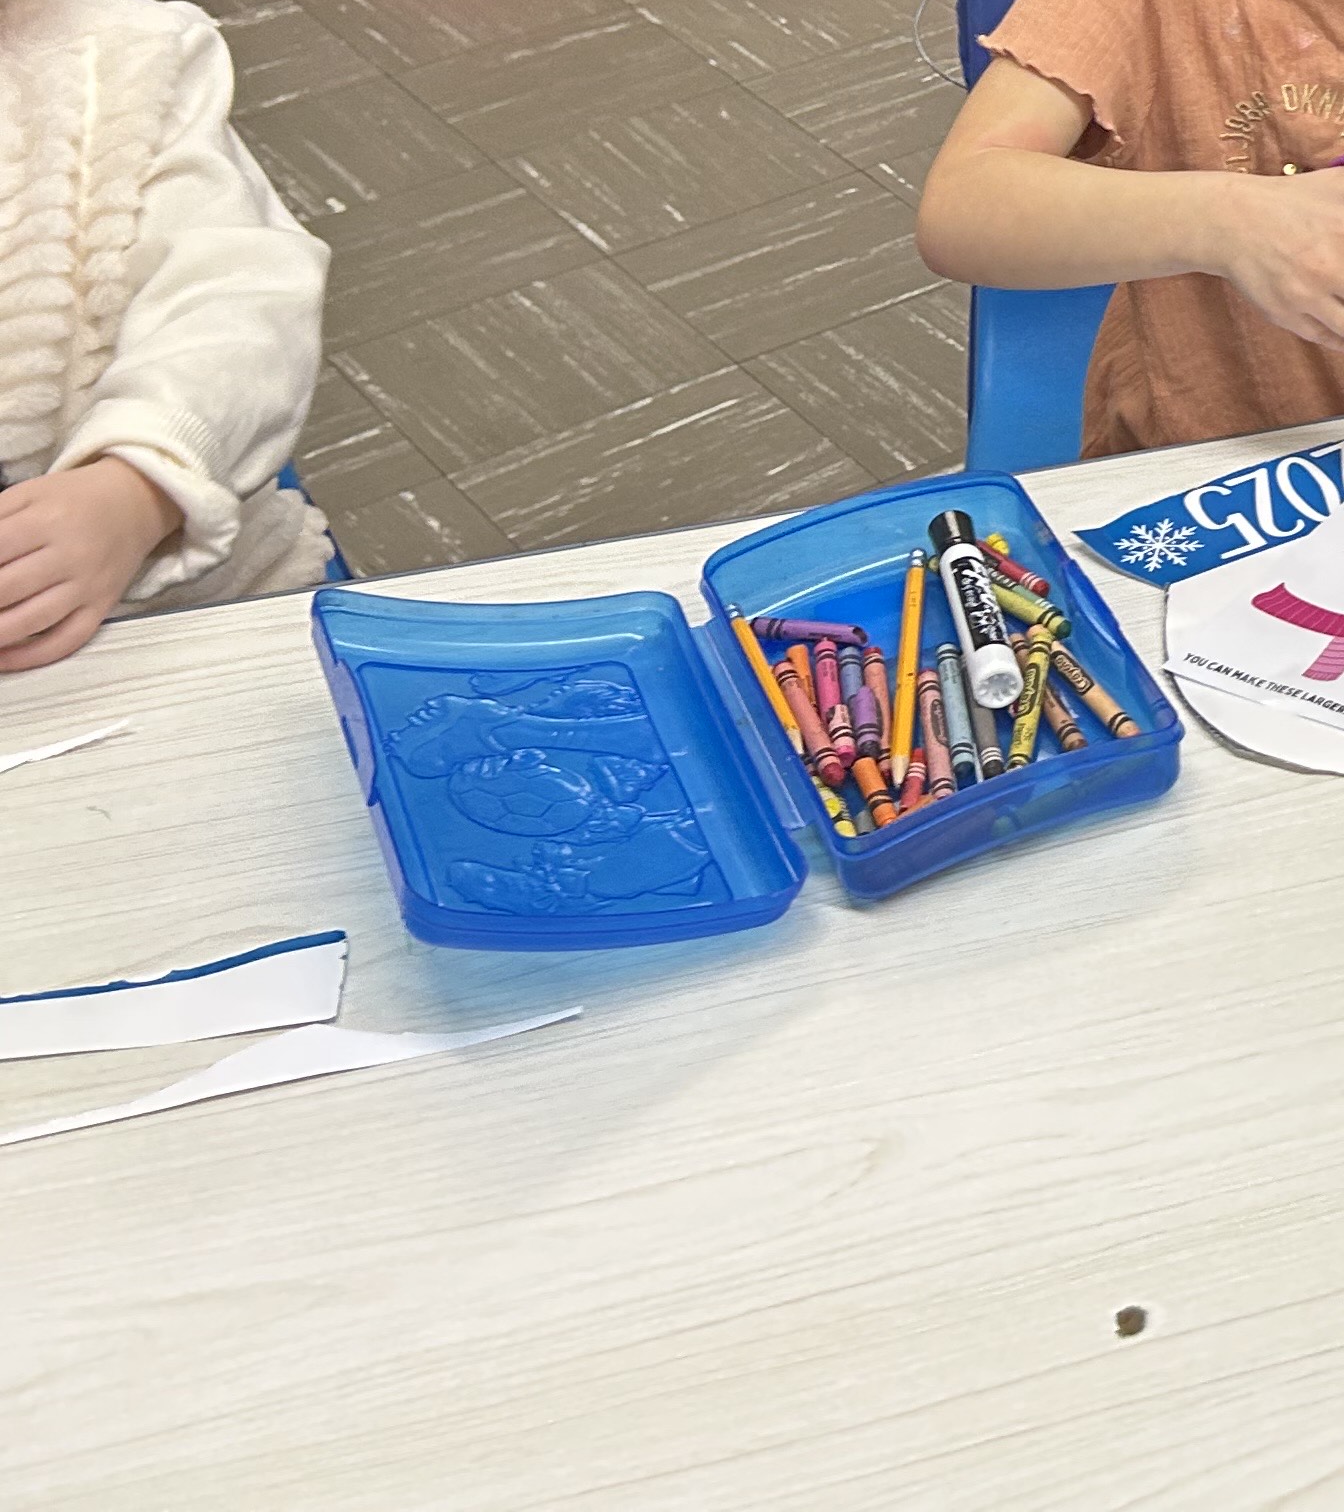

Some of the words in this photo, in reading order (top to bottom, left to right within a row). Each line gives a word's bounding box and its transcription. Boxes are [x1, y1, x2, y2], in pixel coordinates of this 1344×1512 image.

[1183, 652, 1210, 668] YOU
[1206, 660, 1232, 677] CAN
[1231, 669, 1268, 689] MAKE
[1265, 681, 1303, 698] THESE
